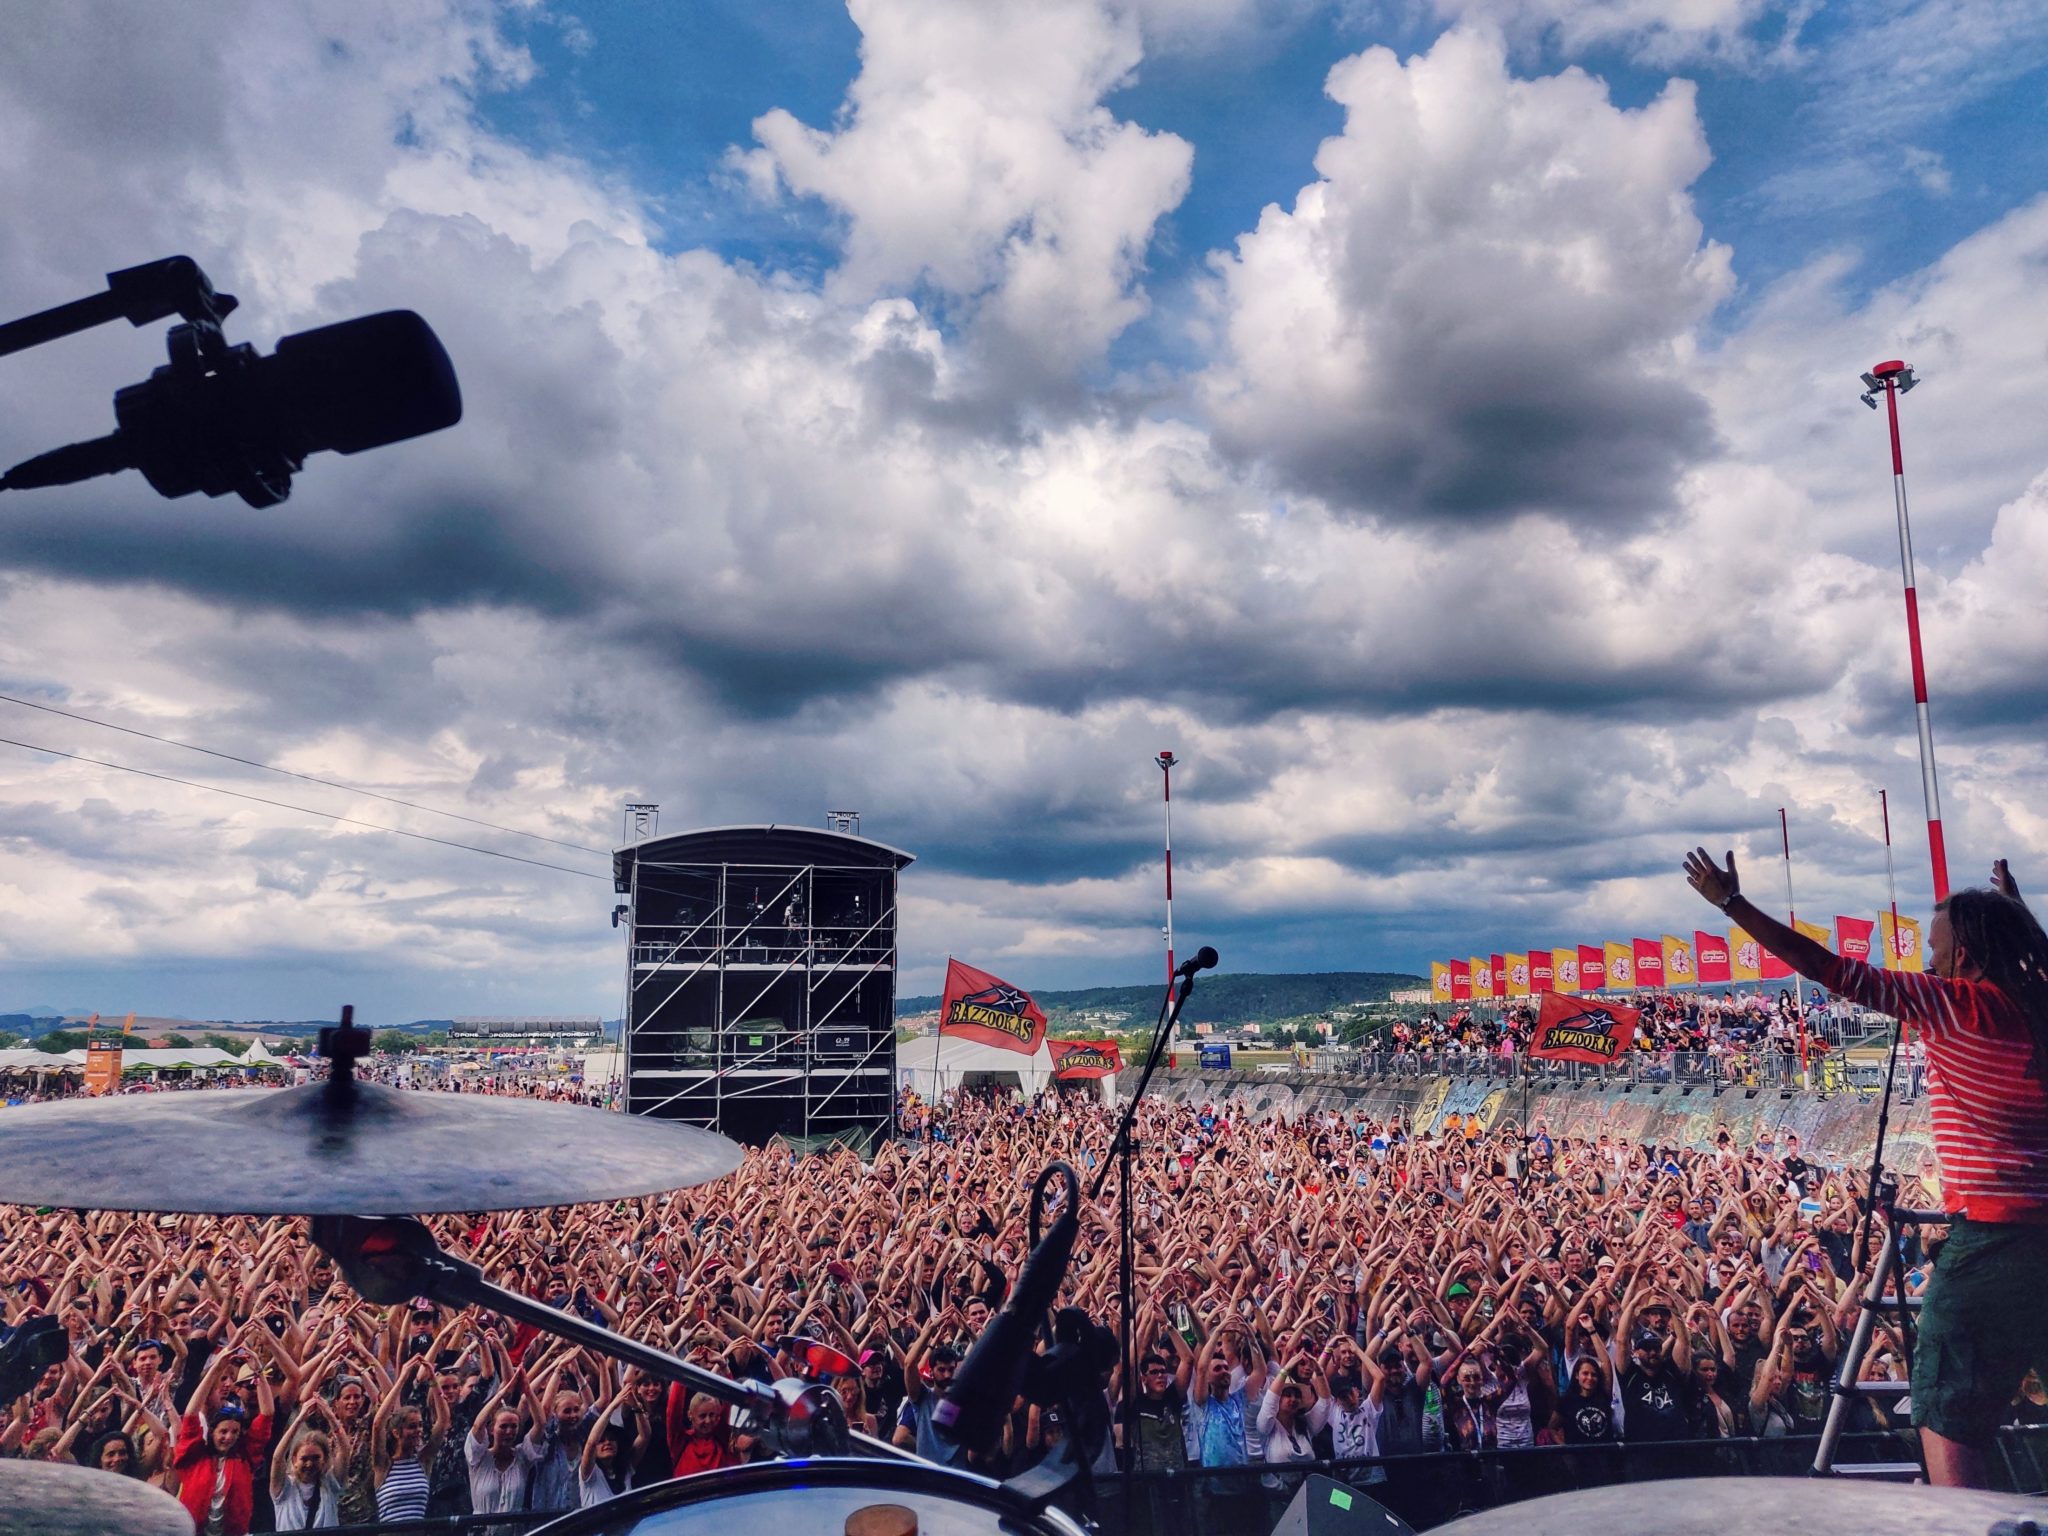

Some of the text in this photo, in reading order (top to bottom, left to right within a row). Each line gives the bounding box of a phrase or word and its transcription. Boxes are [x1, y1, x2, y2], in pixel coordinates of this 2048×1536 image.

[948, 1002, 1034, 1041] BAZZOOKAS
[1545, 1029, 1617, 1056] BAZZOOKAS
[1058, 1055, 1114, 1072] BAZZOOKAS
